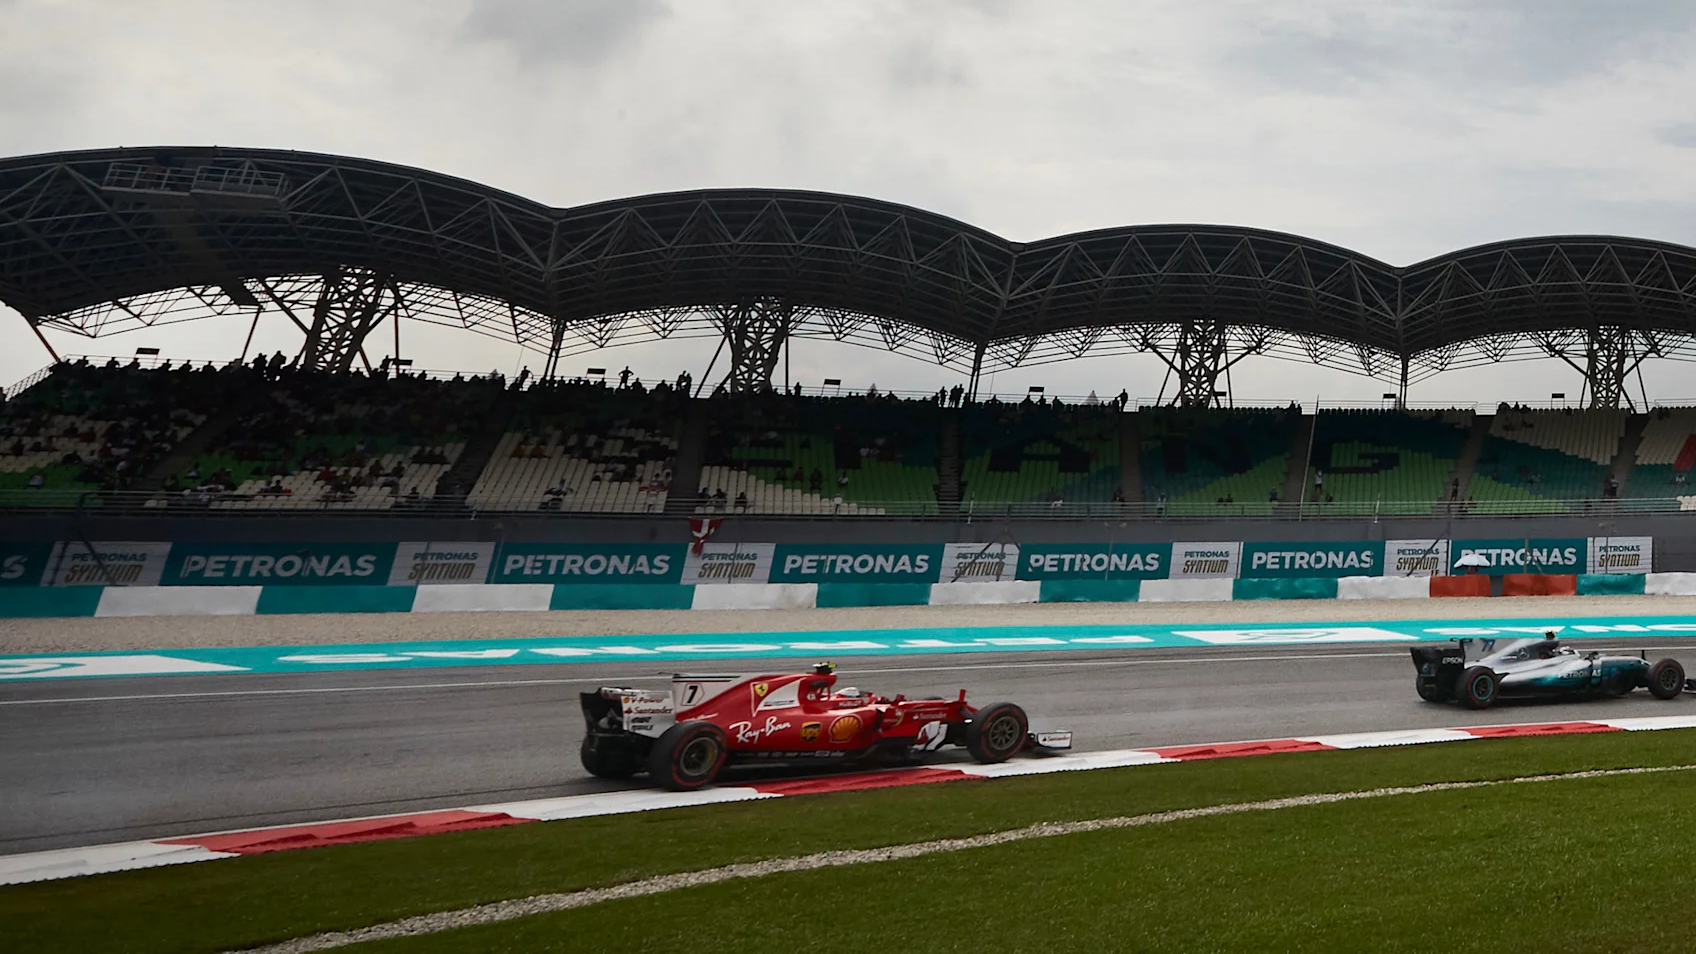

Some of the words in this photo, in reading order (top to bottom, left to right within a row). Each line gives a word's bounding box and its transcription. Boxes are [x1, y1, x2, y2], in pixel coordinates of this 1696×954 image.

[413, 552, 479, 561] PETRONAS
[702, 552, 758, 561] PETRONAS
[1184, 550, 1230, 559] PETRONAS
[1599, 545, 1641, 553] PETRONAS
[180, 554, 377, 579] PETRONAS
[503, 554, 672, 576] PETRONAS
[783, 553, 930, 575] PETRONAS
[1029, 552, 1160, 573] PETRONAS
[1183, 559, 1229, 574] SYNTIUM
[1252, 550, 1375, 570] PETRONAS
[698, 562, 756, 578] SYNTIUM
[687, 685, 699, 704] 7
[633, 705, 674, 715] Santander
[728, 716, 792, 744] Ray-Ban
